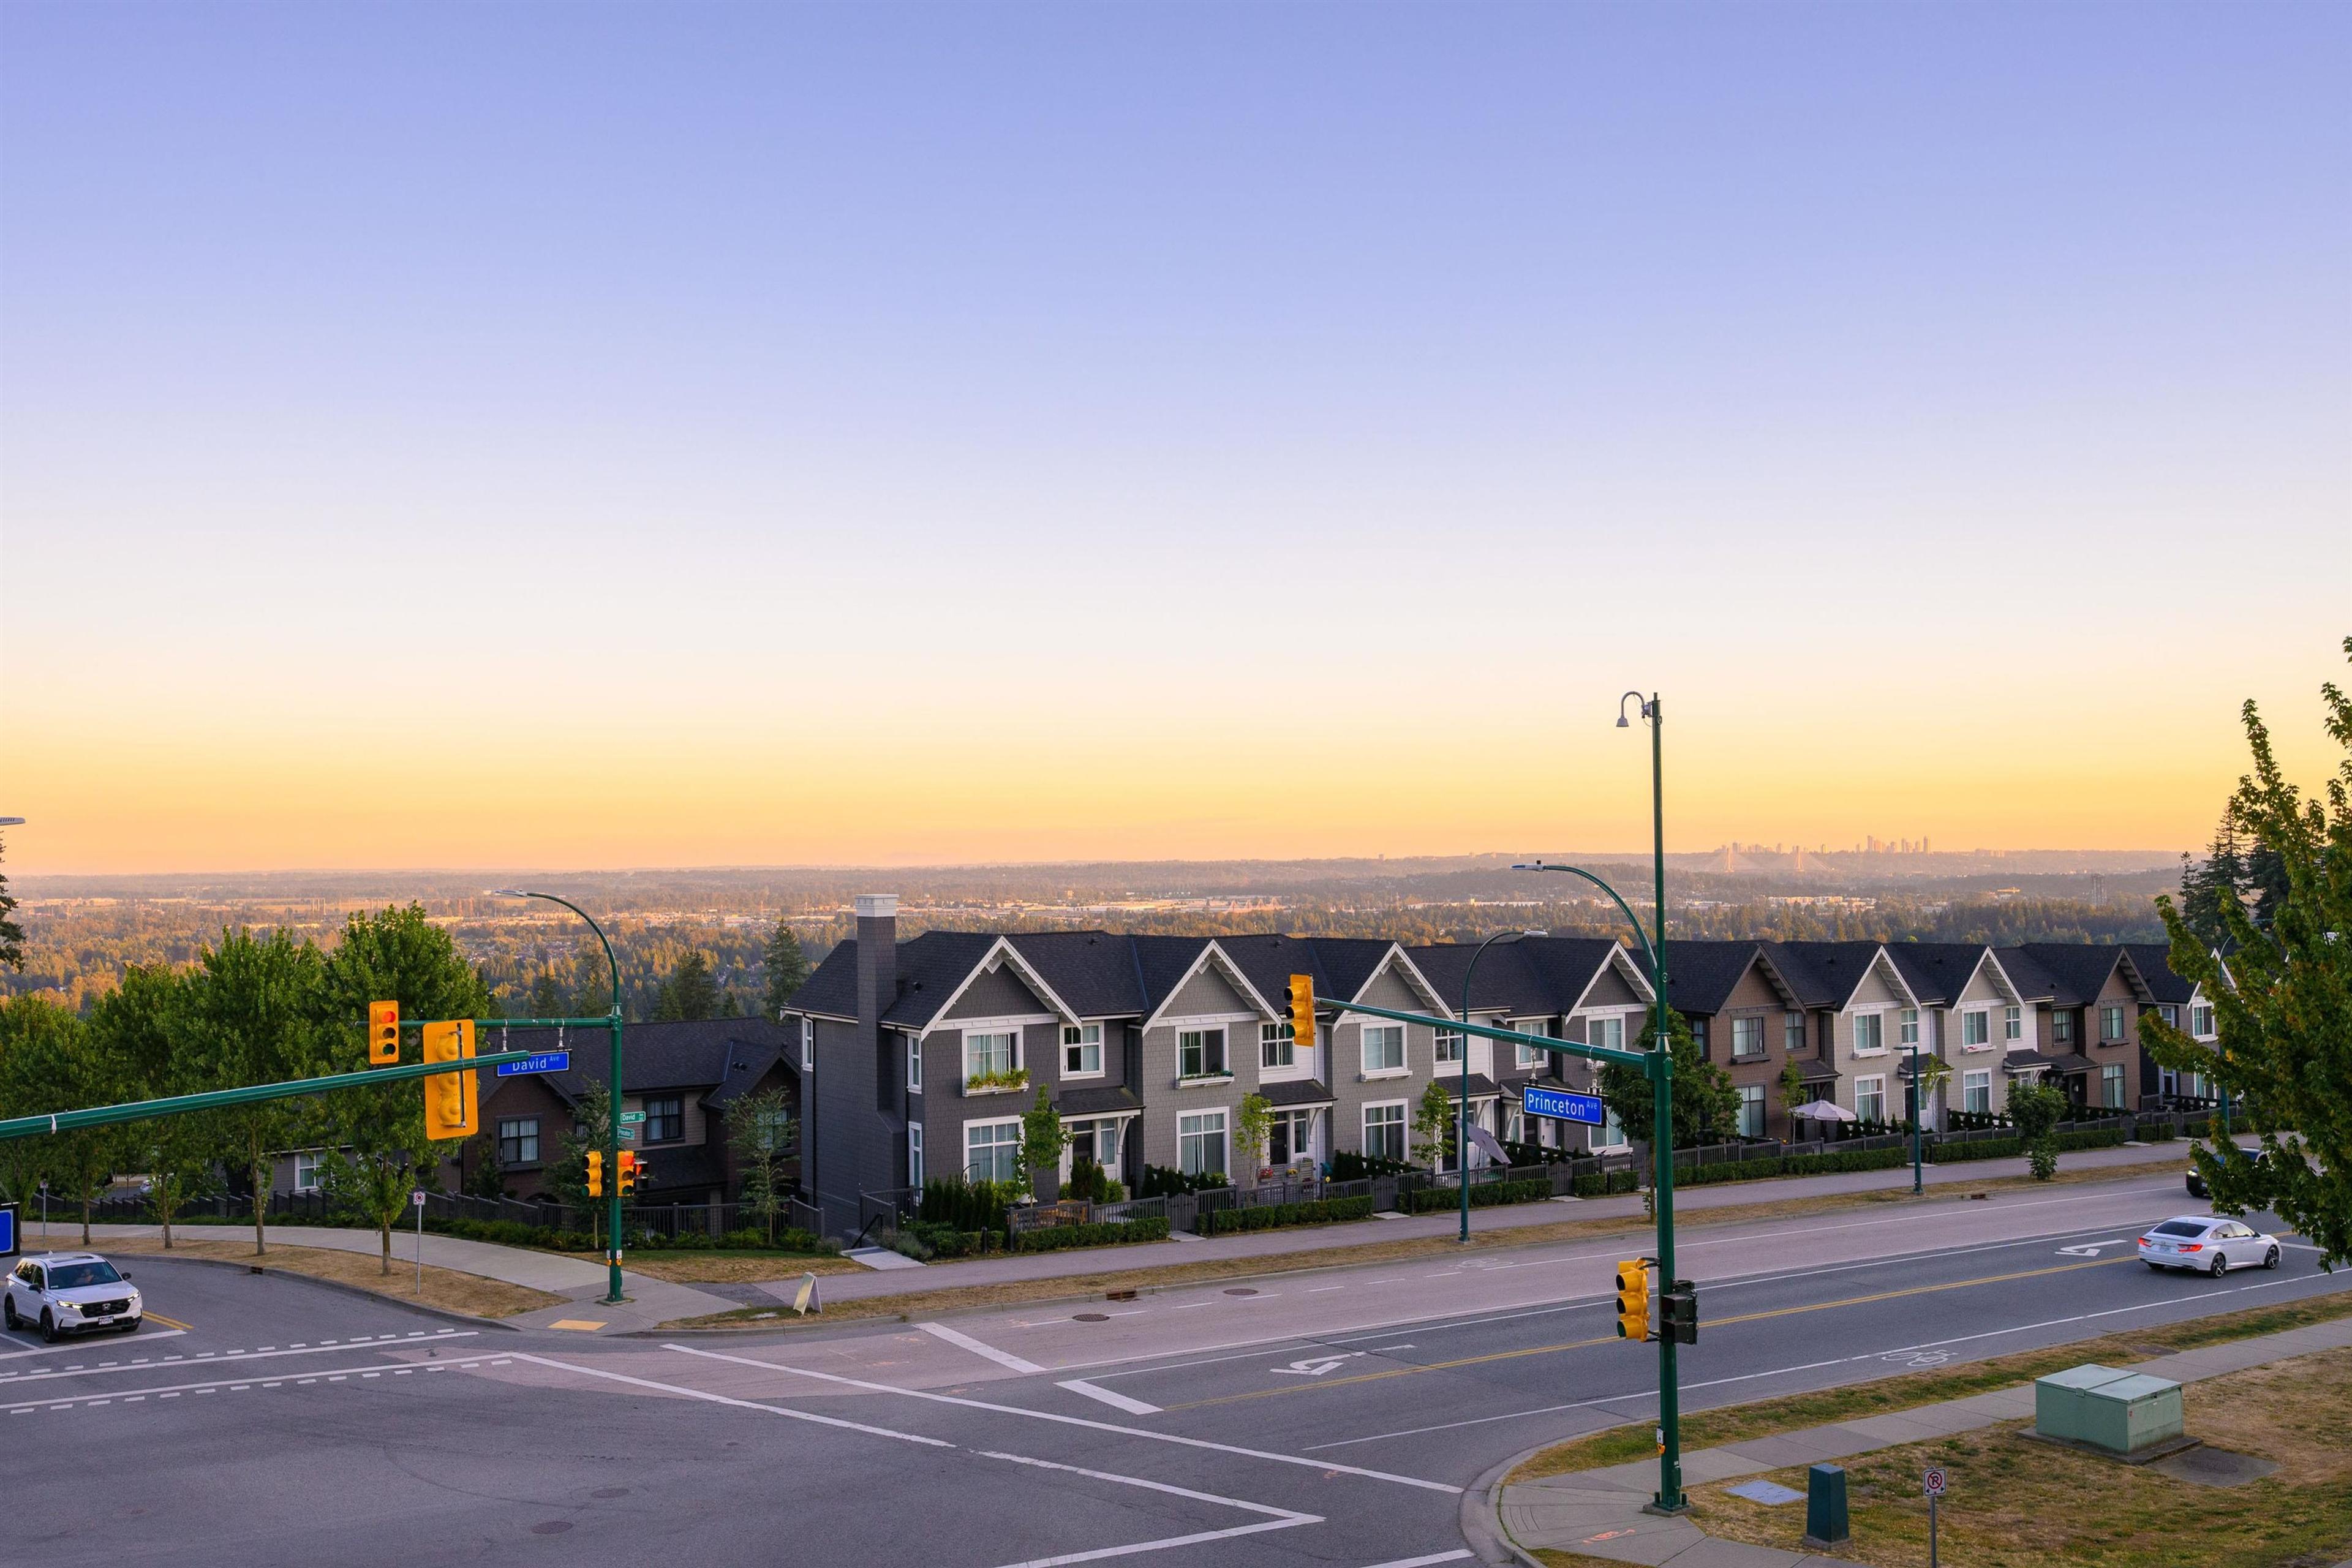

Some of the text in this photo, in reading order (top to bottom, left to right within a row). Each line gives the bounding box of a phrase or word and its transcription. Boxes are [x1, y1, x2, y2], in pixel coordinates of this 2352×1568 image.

[513, 1057, 546, 1071] David
[1528, 1093, 1597, 1117] Princeton Ave
